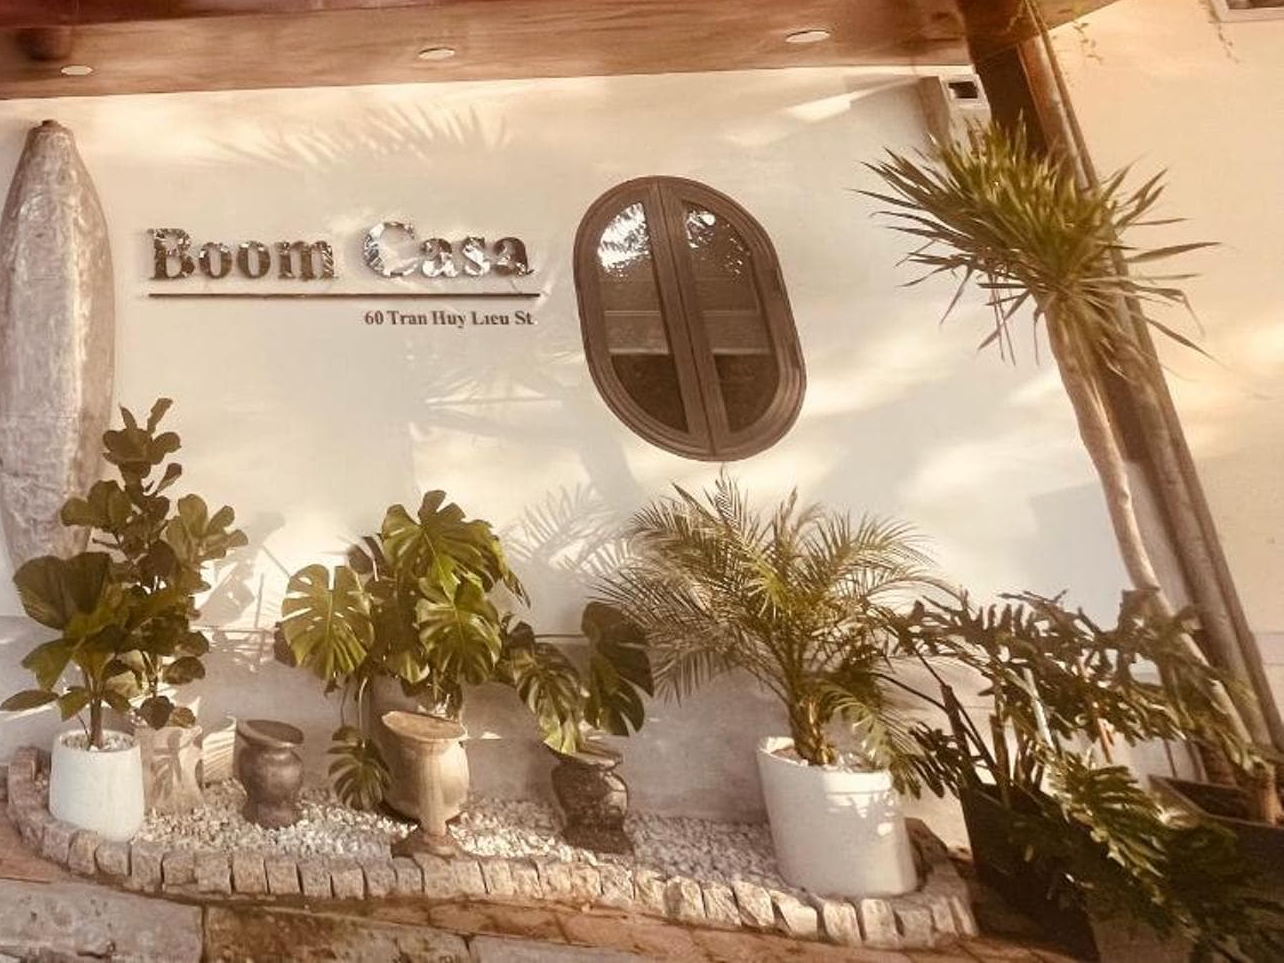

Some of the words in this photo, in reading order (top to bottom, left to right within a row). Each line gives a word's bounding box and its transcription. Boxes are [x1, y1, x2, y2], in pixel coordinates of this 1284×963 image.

[147, 228, 338, 281] Boom
[364, 221, 535, 278] Casa
[364, 310, 384, 325] 60
[387, 310, 427, 325] Tran
[431, 310, 466, 328] Huy
[471, 310, 509, 325] Lieu
